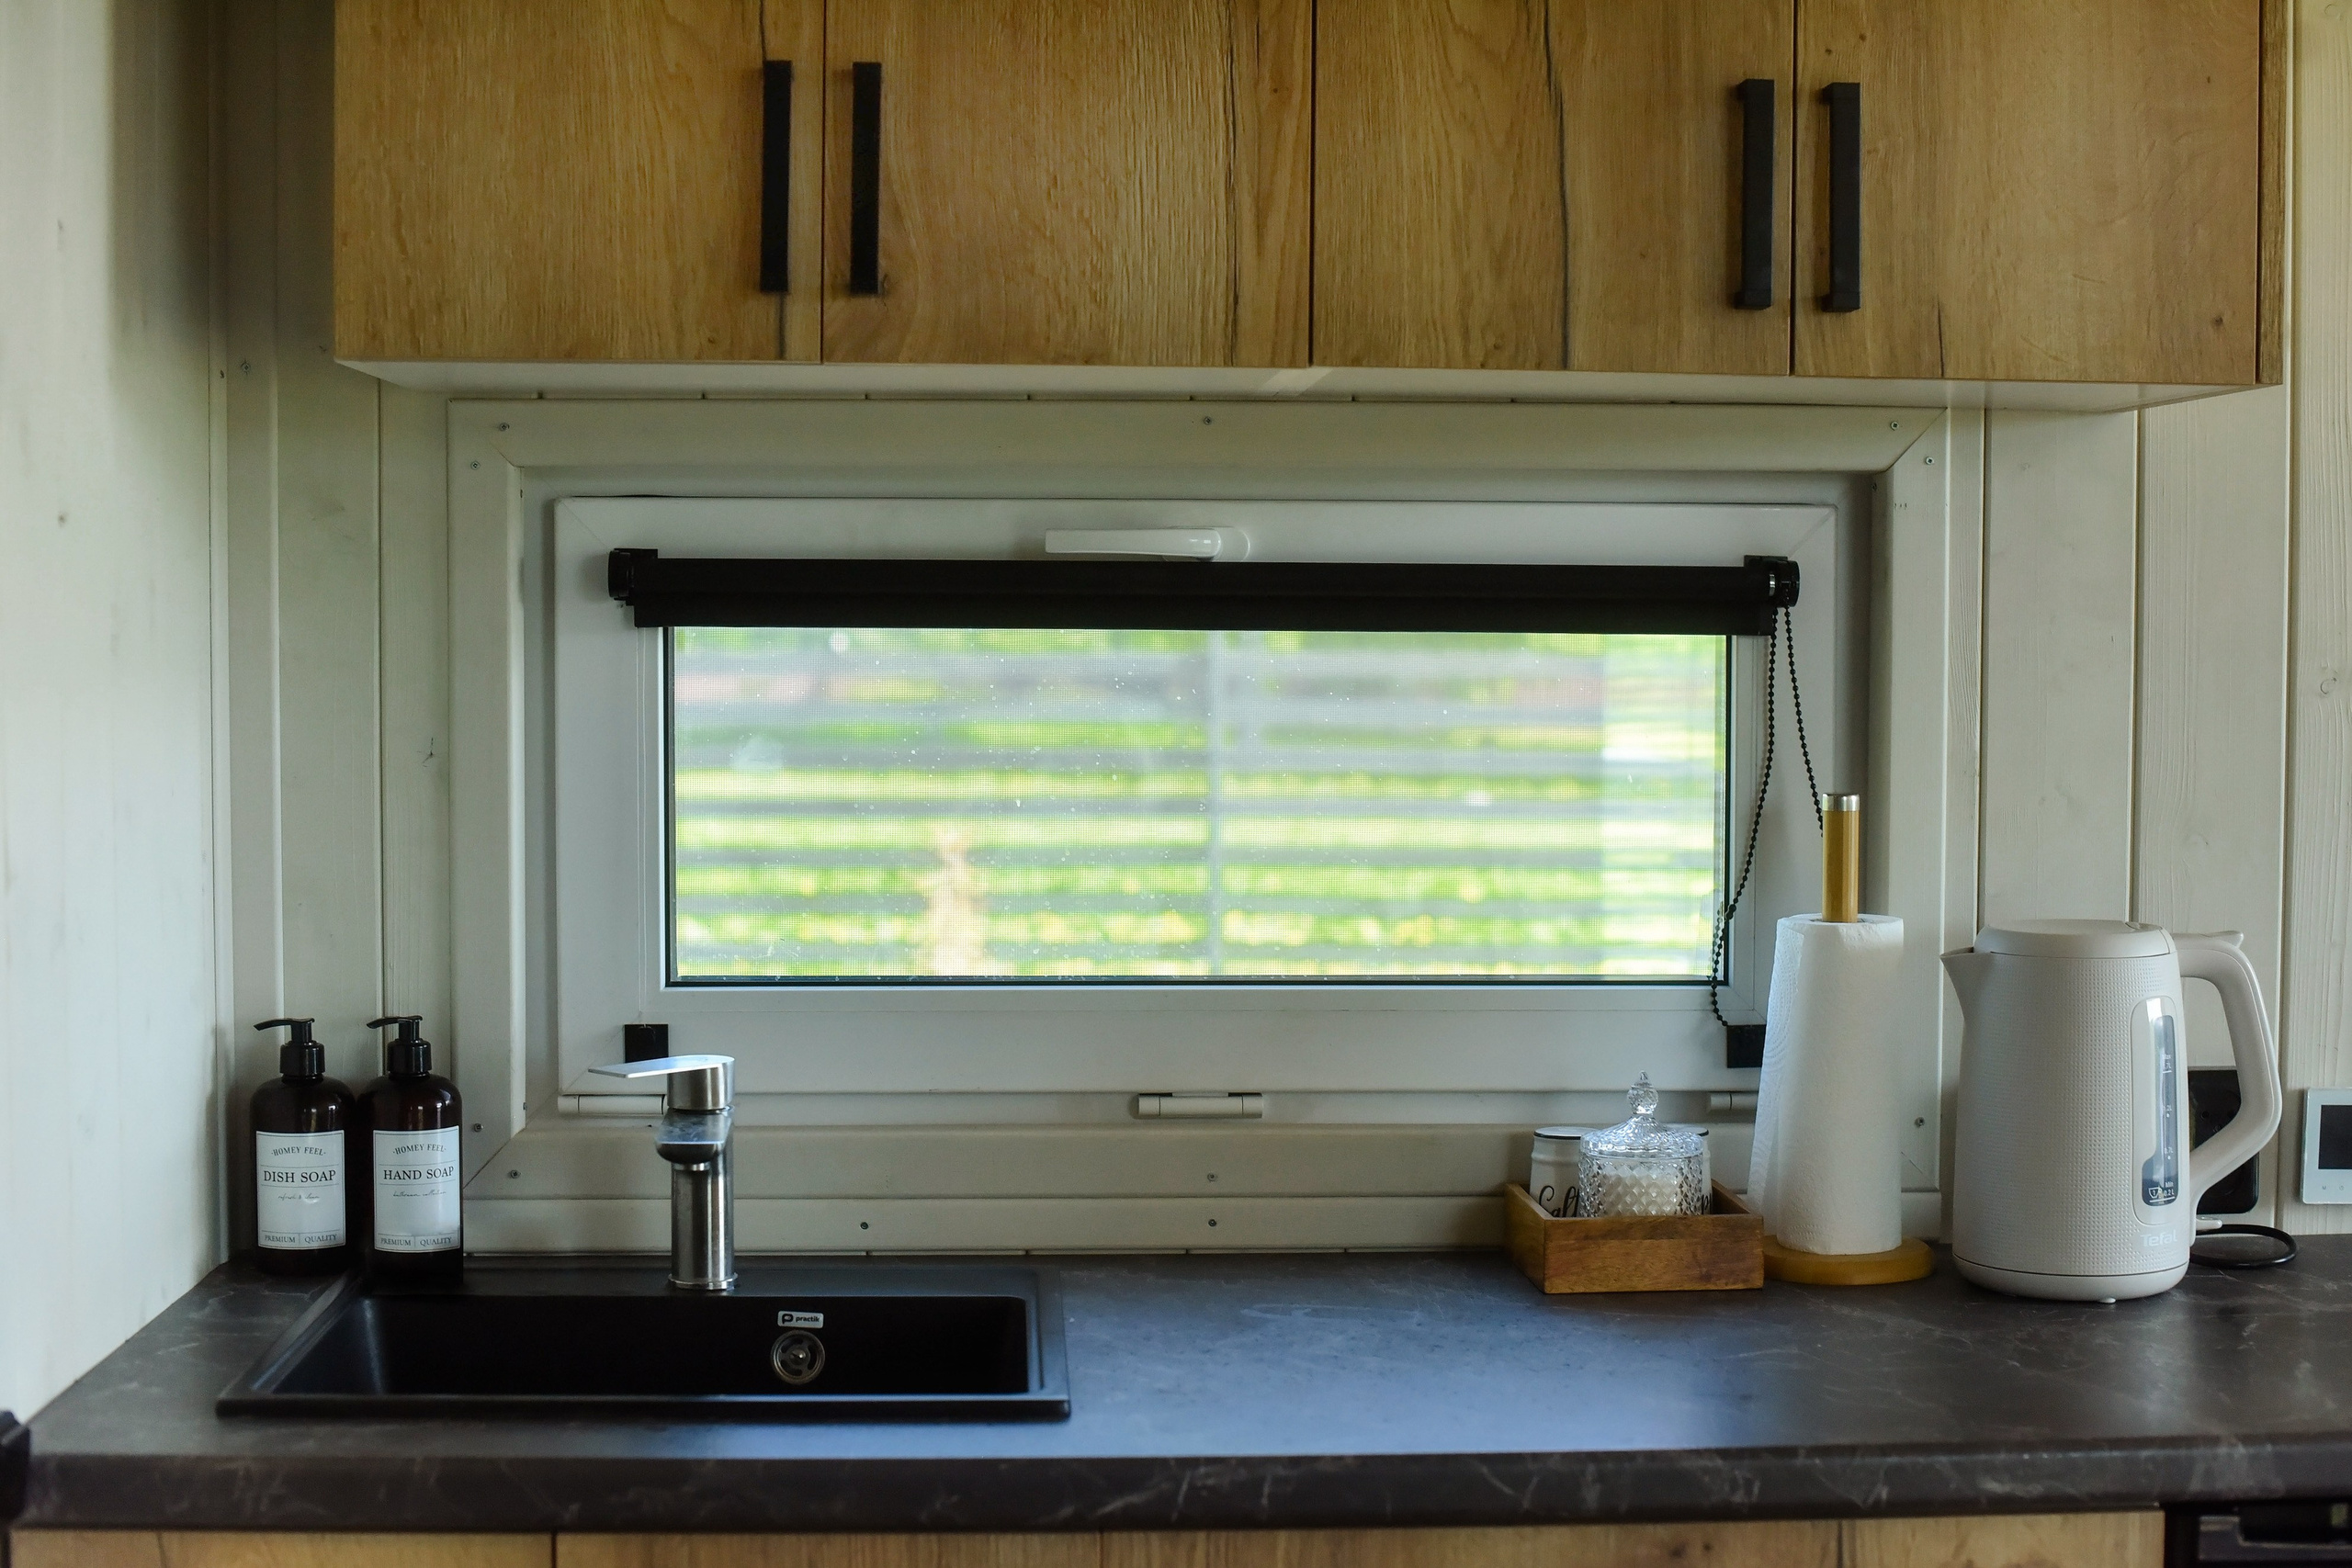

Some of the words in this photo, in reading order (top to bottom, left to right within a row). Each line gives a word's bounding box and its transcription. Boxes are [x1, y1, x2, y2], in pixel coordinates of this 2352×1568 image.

[273, 1146, 301, 1156] HOMEY
[304, 1146, 324, 1156] FEEL
[395, 1144, 424, 1156] HOMEY
[426, 1144, 445, 1153] FEEL
[264, 1170, 295, 1183] DISH
[300, 1169, 336, 1183] SOAP
[383, 1169, 422, 1180] HAND
[426, 1166, 454, 1179] SOAP
[265, 1235, 296, 1244] PREMIUM
[304, 1234, 337, 1244] QUALITY
[380, 1237, 412, 1247] PREMIUM
[420, 1236, 452, 1247] QUALITY
[2140, 1229, 2178, 1247] Tefal
